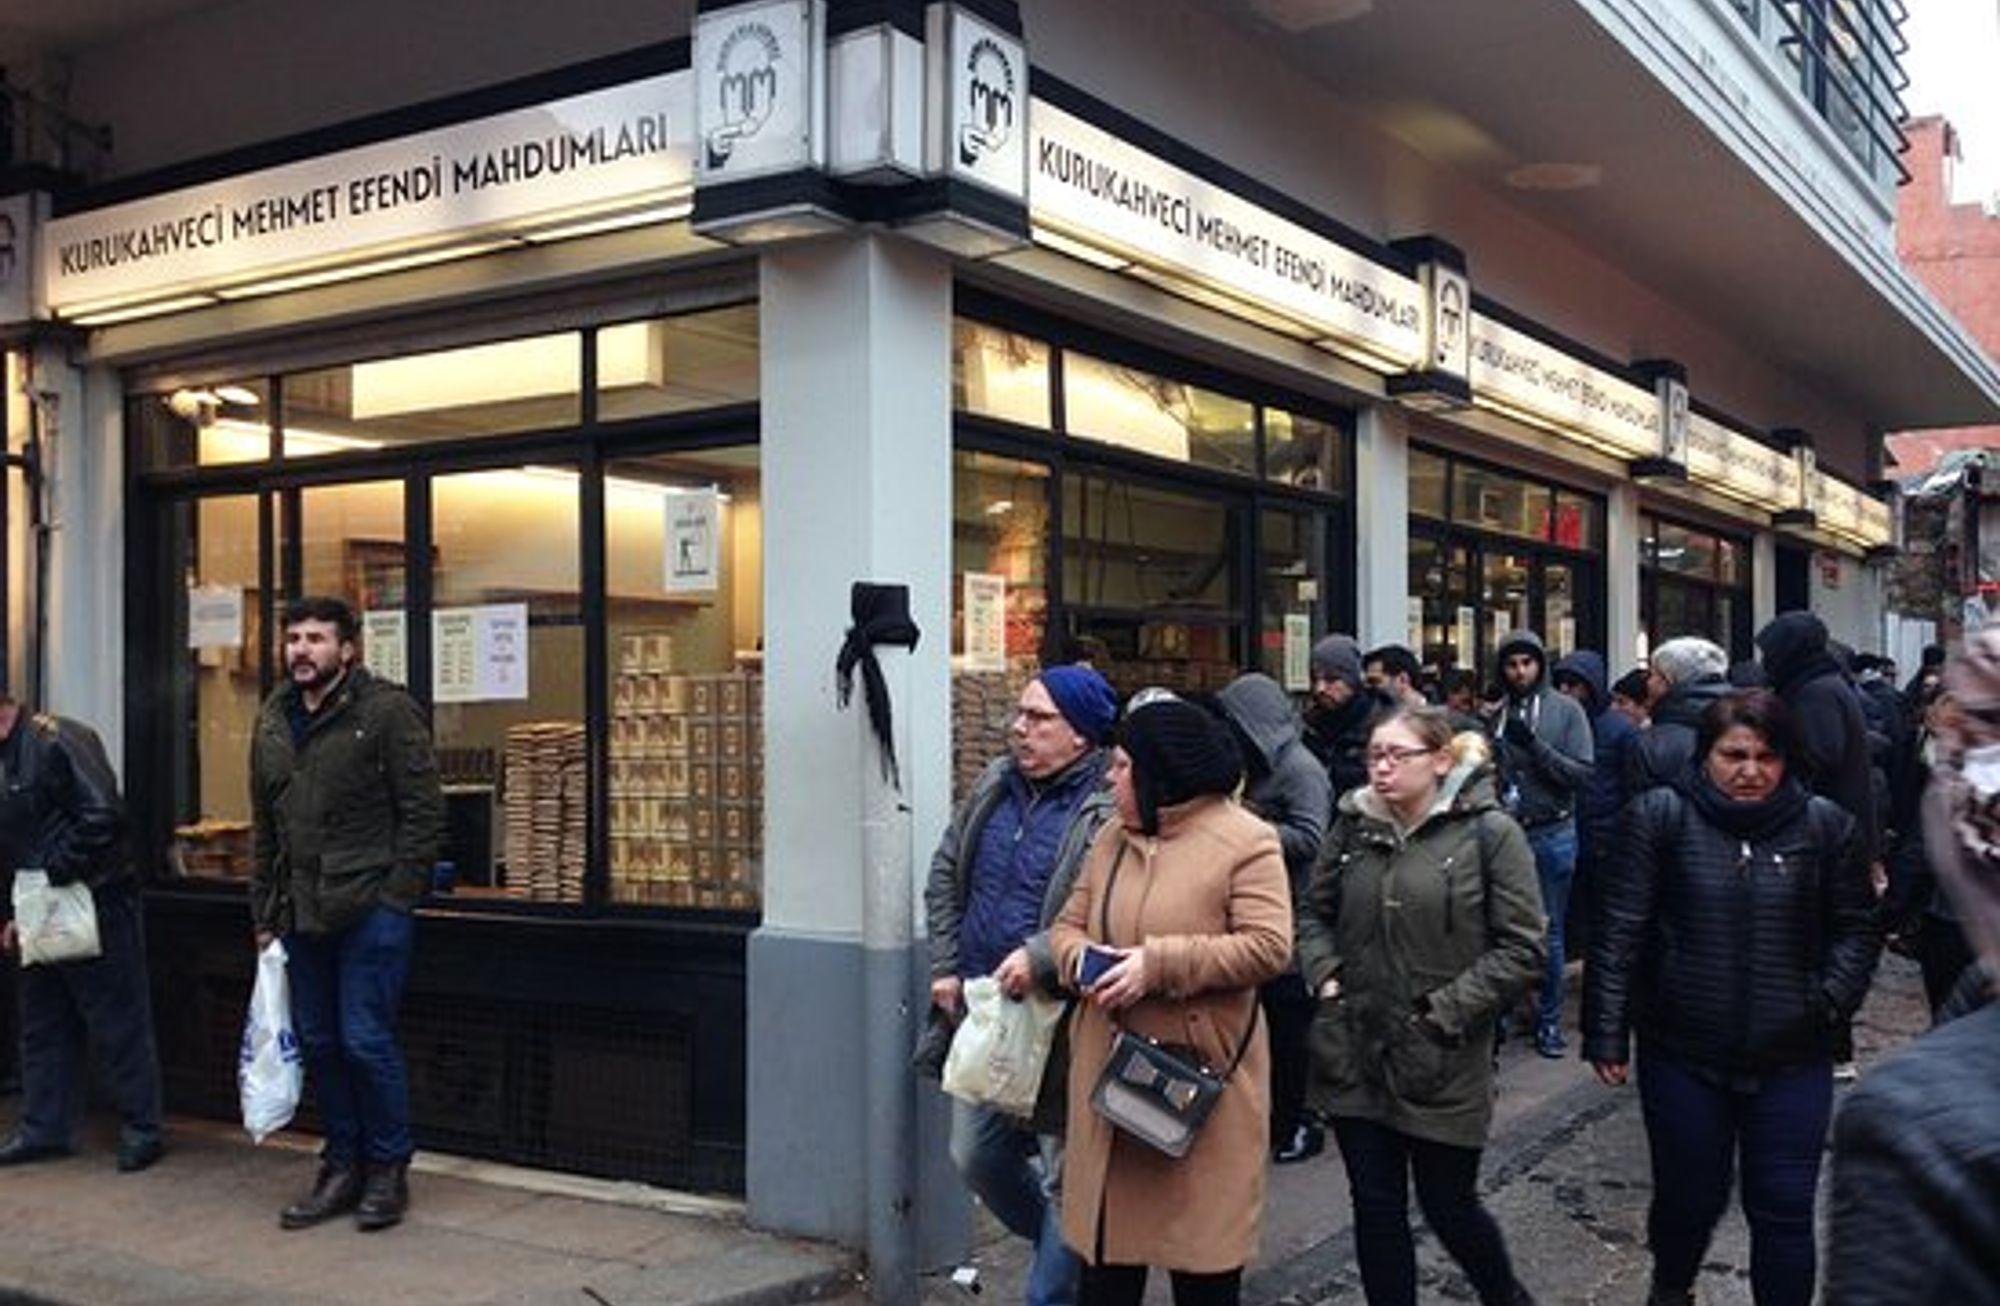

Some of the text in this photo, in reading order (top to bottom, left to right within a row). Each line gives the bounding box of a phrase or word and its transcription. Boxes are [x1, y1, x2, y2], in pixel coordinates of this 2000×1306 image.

[60, 113, 668, 277] KURUKAHVECİ MEHMET EFENDİ MAHDUMLARI
[1038, 136, 1191, 235] KURUKAHVECİ
[1197, 210, 1269, 271] MEHMET
